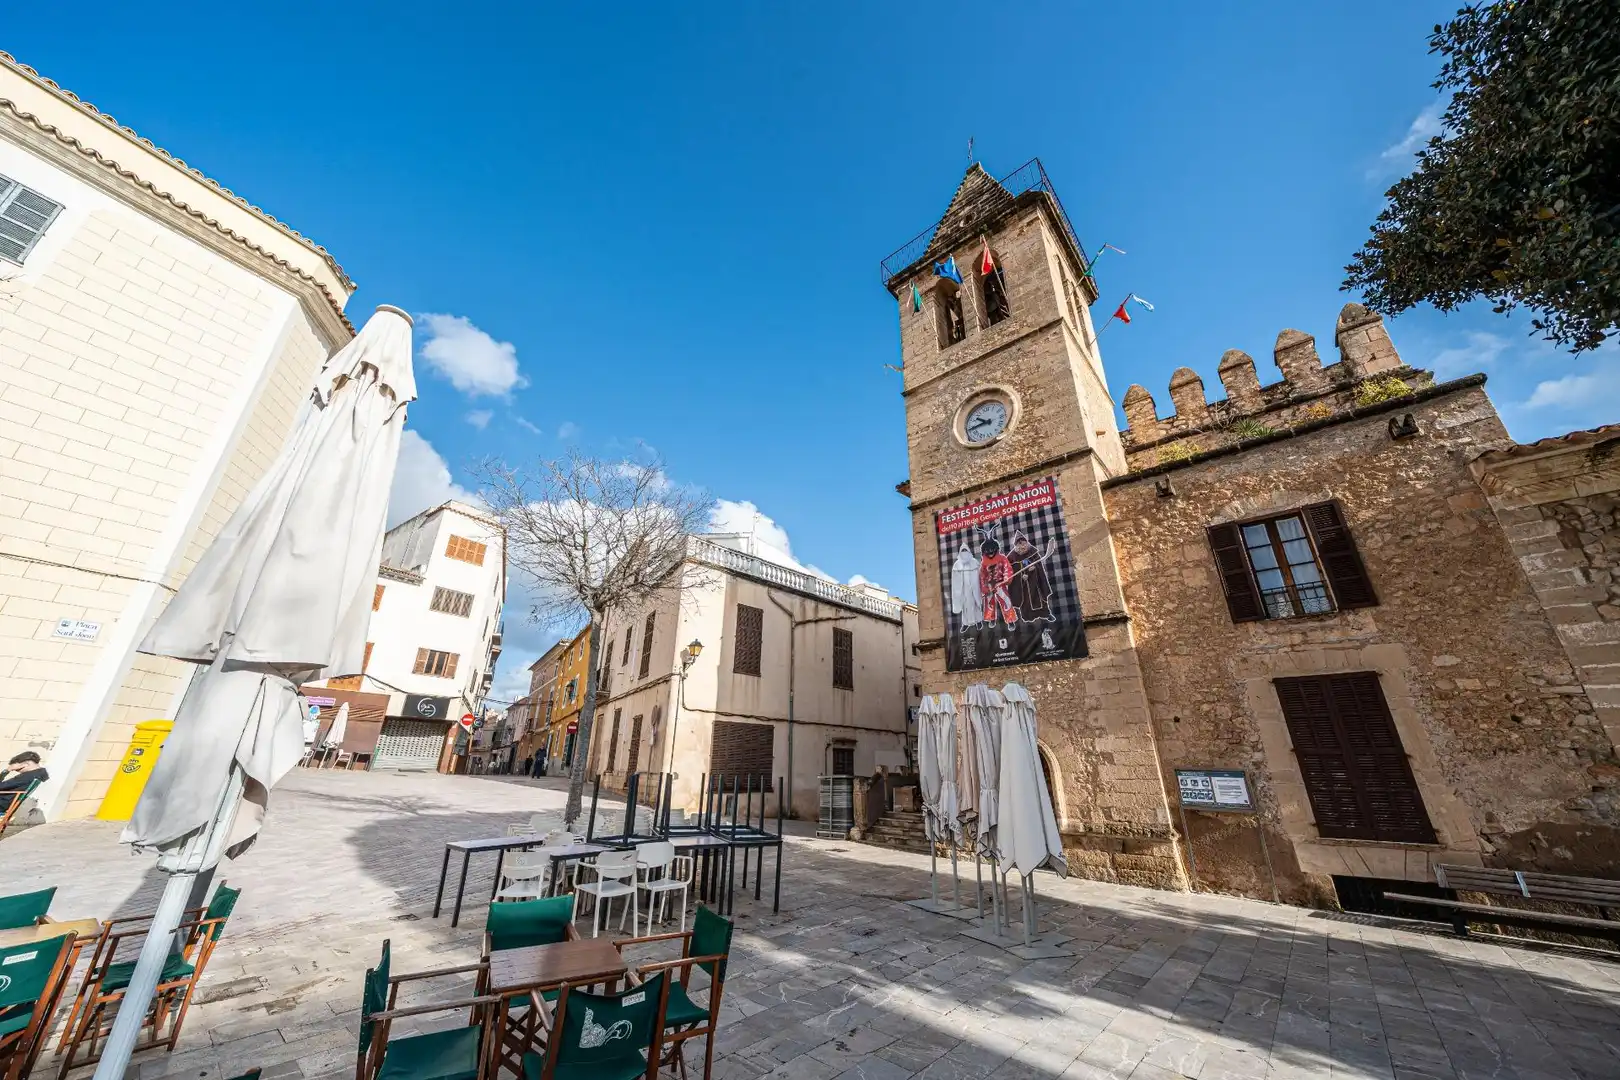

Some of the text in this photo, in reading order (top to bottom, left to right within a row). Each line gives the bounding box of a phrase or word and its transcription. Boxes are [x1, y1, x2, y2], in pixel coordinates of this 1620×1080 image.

[941, 485, 1050, 523] FESTES DE SANT ANTONI
[1002, 506, 1017, 515] SON
[1018, 496, 1053, 511] SERVERA
